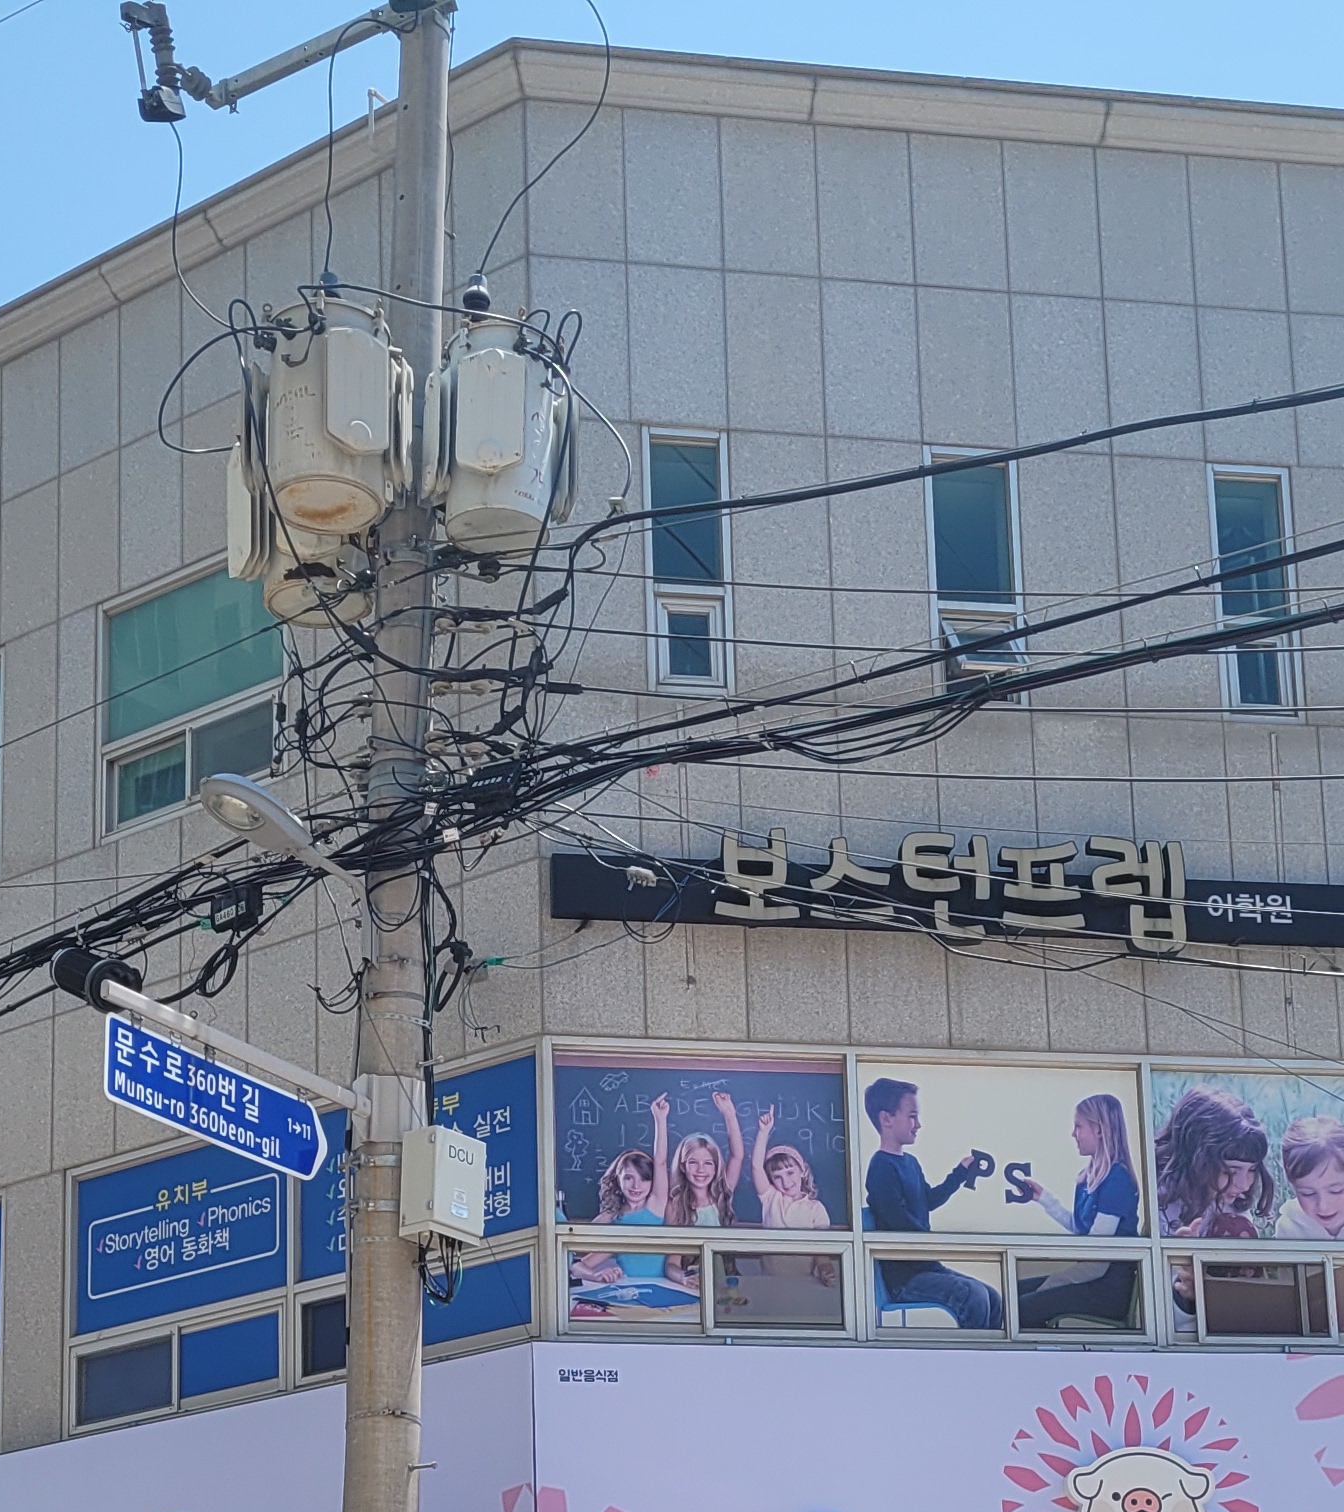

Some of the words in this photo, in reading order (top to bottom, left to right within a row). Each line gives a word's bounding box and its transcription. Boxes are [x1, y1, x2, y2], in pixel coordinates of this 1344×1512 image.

[713, 826, 1189, 954] 보스턴프렙
[114, 1026, 260, 1123] 문수로360번길
[114, 1069, 185, 1119] Munsu-ro
[189, 1102, 281, 1159] 360beon-gil
[472, 1105, 512, 1139] 실전
[448, 1144, 475, 1166] DCU
[155, 1179, 208, 1212] 유치부
[105, 1218, 190, 1254] Storytelling
[208, 1197, 271, 1227] Phonics
[144, 1241, 174, 1270] 영어
[180, 1226, 230, 1261] 동화책
[558, 1368, 619, 1383] 일반음식점
